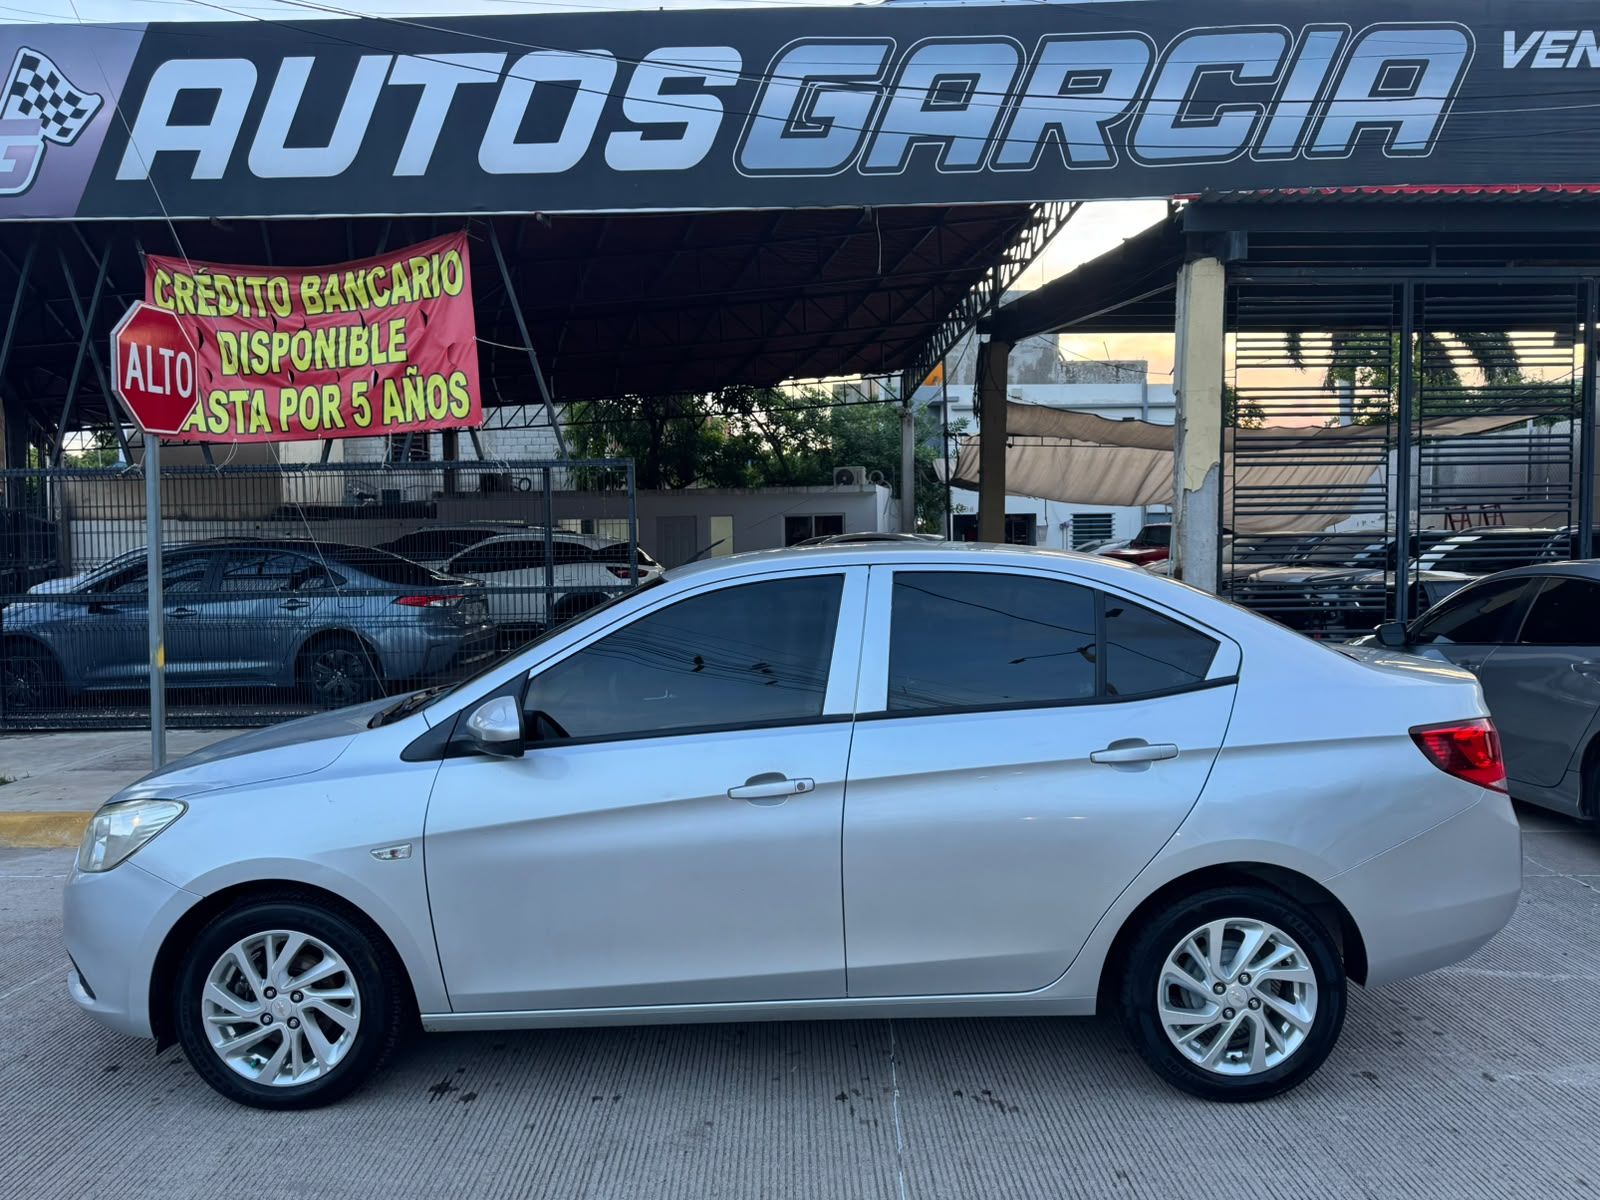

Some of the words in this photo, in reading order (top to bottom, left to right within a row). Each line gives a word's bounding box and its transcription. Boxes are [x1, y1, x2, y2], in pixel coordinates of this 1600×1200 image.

[115, 46, 743, 181] AUTOS
[734, 22, 1475, 178] GARCIA
[153, 267, 293, 318] CRÉDITO
[300, 248, 465, 316] BANCARIO
[125, 341, 193, 398] ALTO
[216, 317, 409, 377] DISPONIBLE
[181, 388, 272, 434] ASTA
[279, 384, 346, 432] POR
[351, 381, 372, 428] 5
[382, 365, 471, 426] AÑOS
